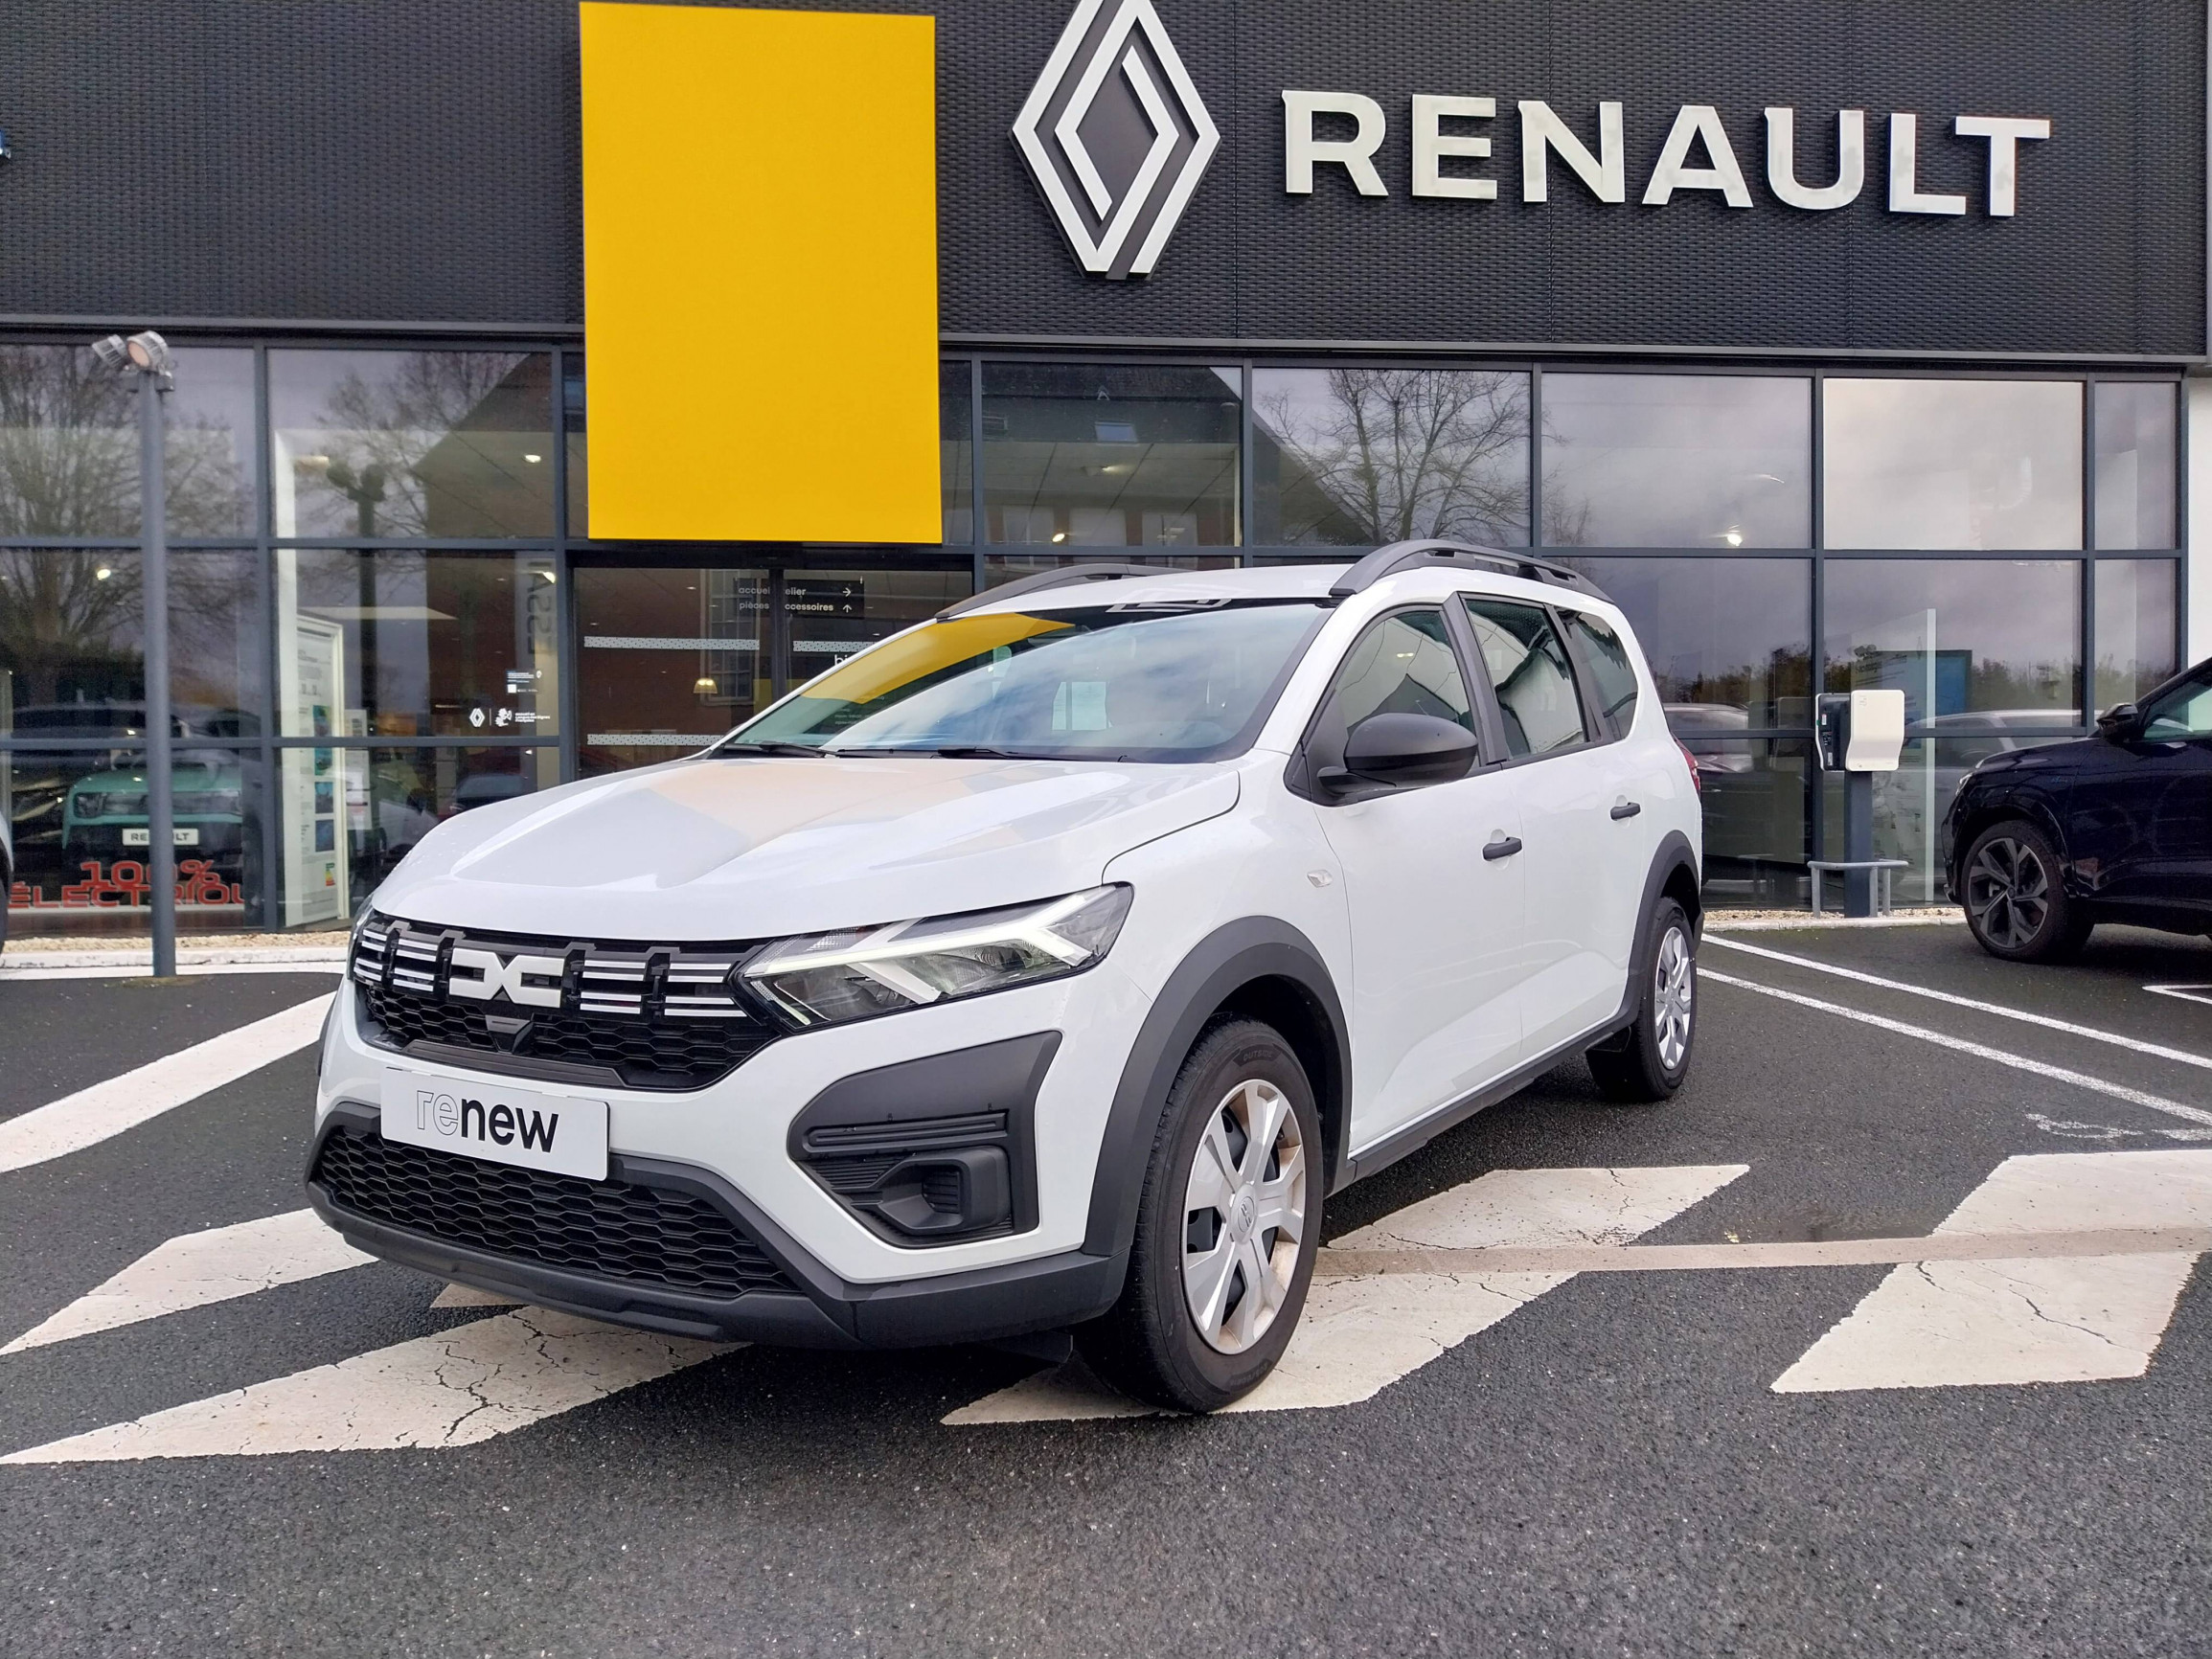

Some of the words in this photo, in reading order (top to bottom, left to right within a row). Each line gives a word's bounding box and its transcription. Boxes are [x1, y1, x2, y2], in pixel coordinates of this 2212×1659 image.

[1282, 90, 2051, 217] RENAULT
[738, 586, 770, 595] accuei
[785, 602, 834, 612] ccessoires
[130, 832, 190, 842] RELT
[80, 859, 221, 889] 10%
[416, 1089, 559, 1153] renew
